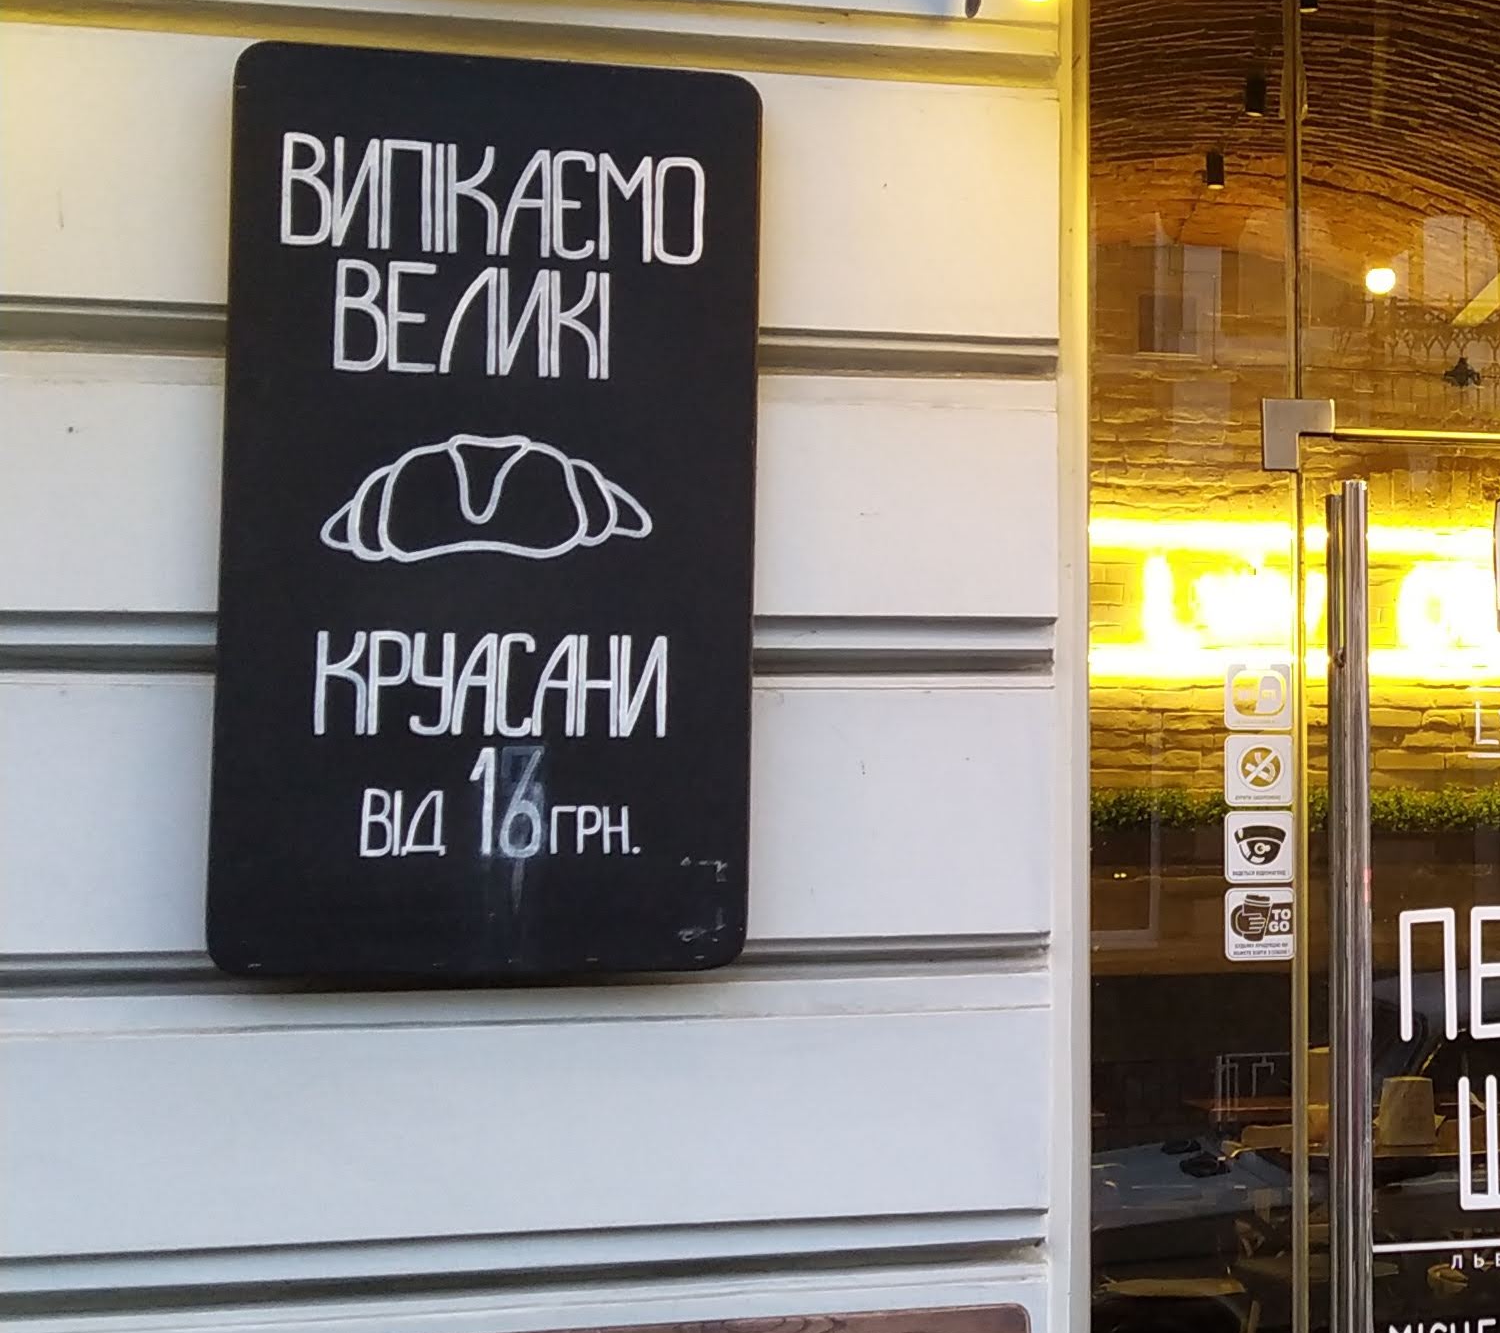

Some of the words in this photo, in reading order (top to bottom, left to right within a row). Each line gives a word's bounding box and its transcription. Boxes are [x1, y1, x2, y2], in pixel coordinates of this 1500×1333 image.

[280, 131, 706, 267] ВИПІКАЄМО
[333, 257, 610, 380] ВЕЛИКІ
[314, 630, 668, 738] КРУАСАНИ
[359, 787, 446, 858] ВІД
[469, 746, 544, 859] 16
[549, 804, 642, 855] ГРН.
[1268, 920, 1290, 933] GO
[1271, 908, 1291, 921] TO
